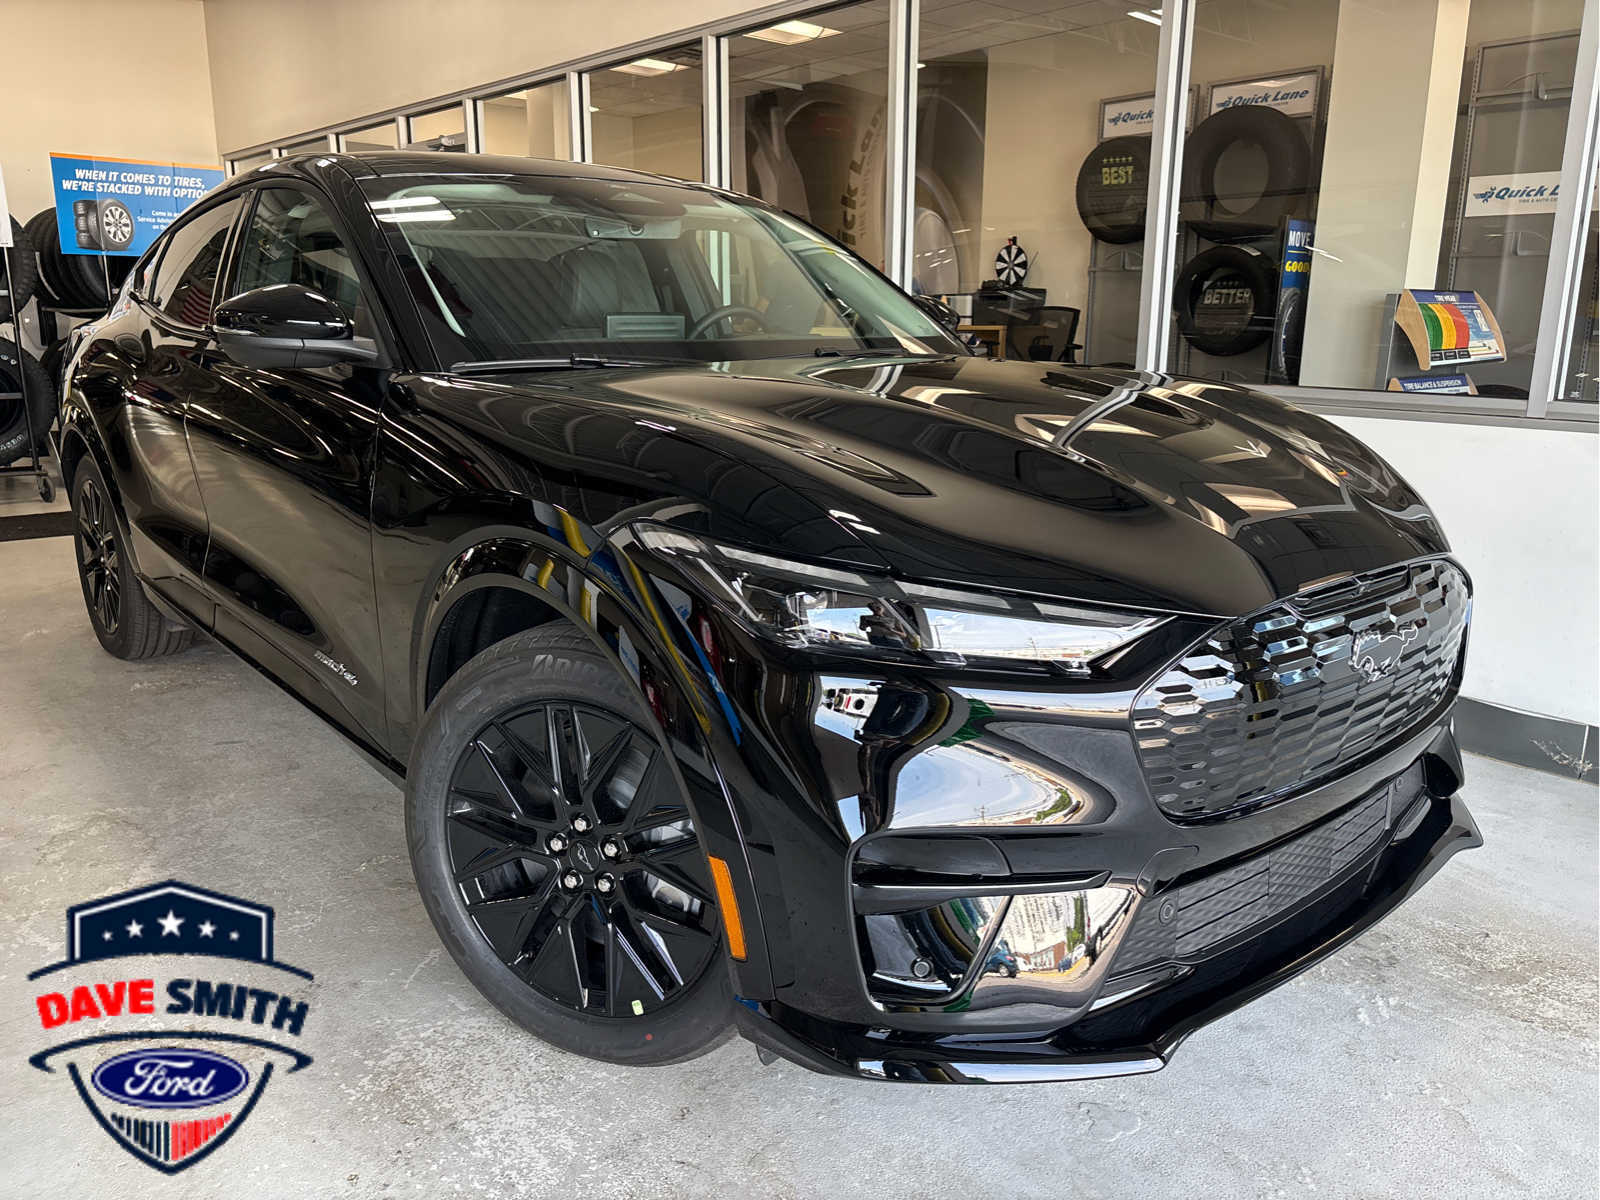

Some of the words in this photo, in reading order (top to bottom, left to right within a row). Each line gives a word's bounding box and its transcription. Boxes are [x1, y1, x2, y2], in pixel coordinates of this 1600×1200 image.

[1232, 92, 1271, 106] Quick
[1272, 89, 1310, 102] Lane
[1121, 109, 1154, 123] Quick
[74, 168, 107, 181] WHEN
[108, 171, 119, 182] IT
[120, 172, 155, 184] COMES
[157, 175, 171, 186] TO
[174, 176, 206, 189] TIRES,
[1102, 166, 1134, 185] BEST
[62, 179, 95, 192] WE'RE
[96, 182, 142, 195] STACKED
[144, 186, 171, 197] WITH
[172, 189, 209, 199] OPTIO
[1495, 185, 1549, 200] Quick
[1288, 230, 1312, 248] MOVE
[1285, 260, 1311, 273] GOOD
[1203, 288, 1251, 305] BETTER
